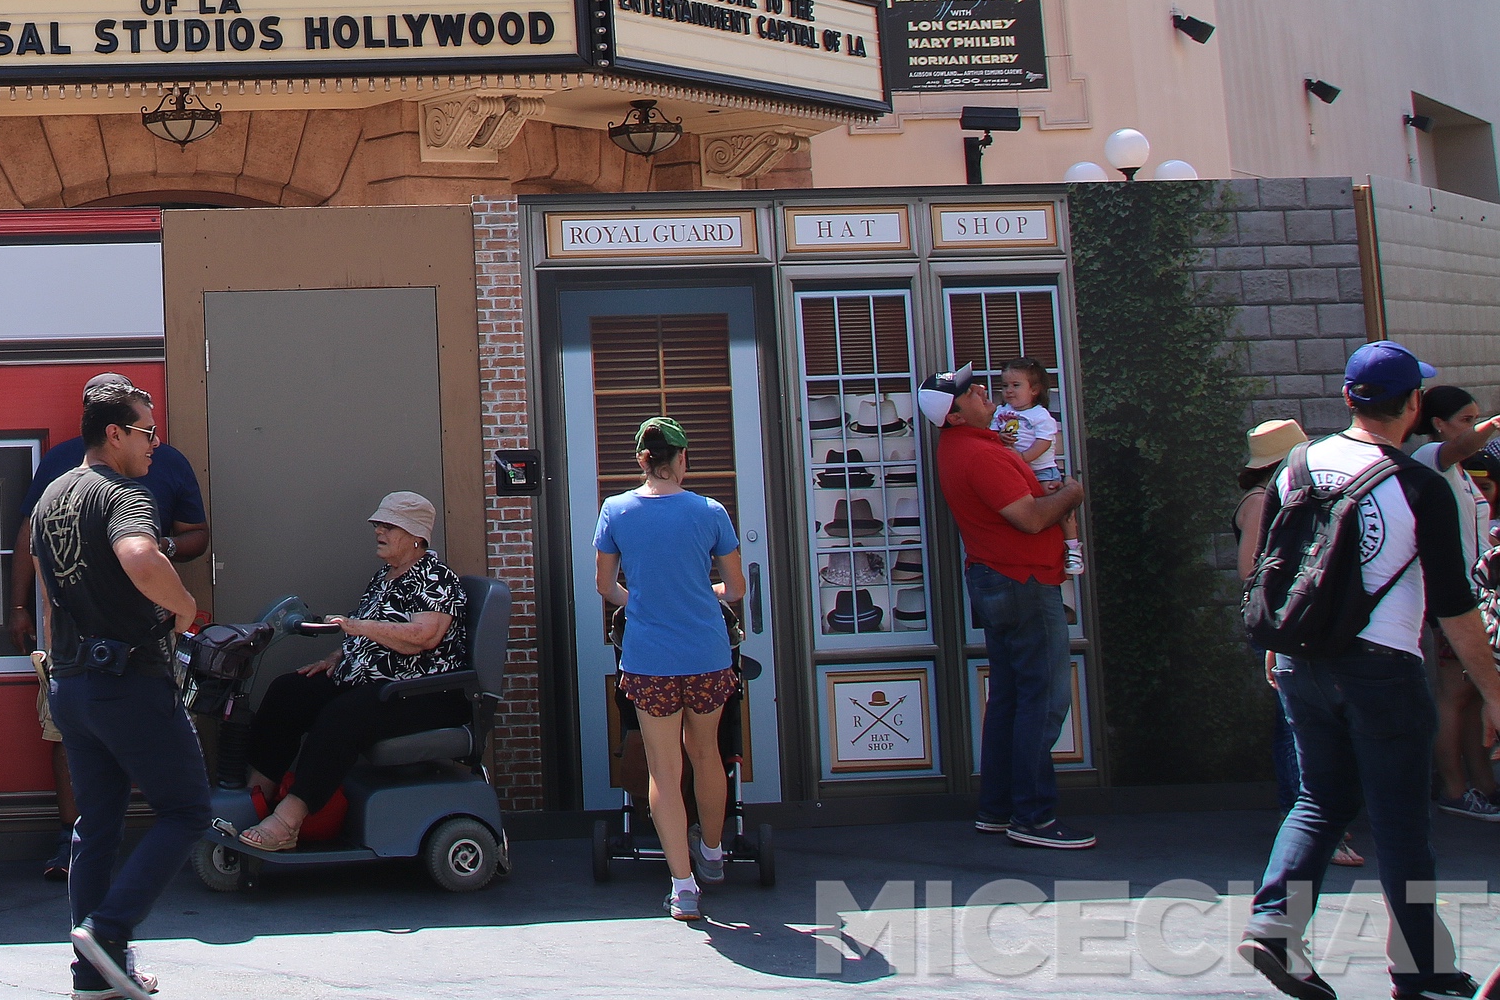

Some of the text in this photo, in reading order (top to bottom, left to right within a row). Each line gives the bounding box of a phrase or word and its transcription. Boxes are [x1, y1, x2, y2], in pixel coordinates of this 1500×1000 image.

[950, 9, 972, 17] WITH
[908, 19, 1016, 31] LON CHANEY
[94, 16, 283, 55] STUDIOS
[305, 11, 555, 50] HOLLYWOOD
[757, 14, 819, 49] CAPITAL
[823, 28, 841, 53] OF
[847, 33, 867, 57] LA
[908, 36, 1016, 49] MARY PHILBIN
[909, 54, 1019, 66] NORMAN KERRY
[815, 218, 876, 239] HAT
[956, 215, 1029, 236] SHOP
[569, 223, 734, 245] ROYAL GUARD
[853, 713, 904, 728] R G
[871, 733, 890, 742] HAT
[867, 743, 894, 751] SHOP
